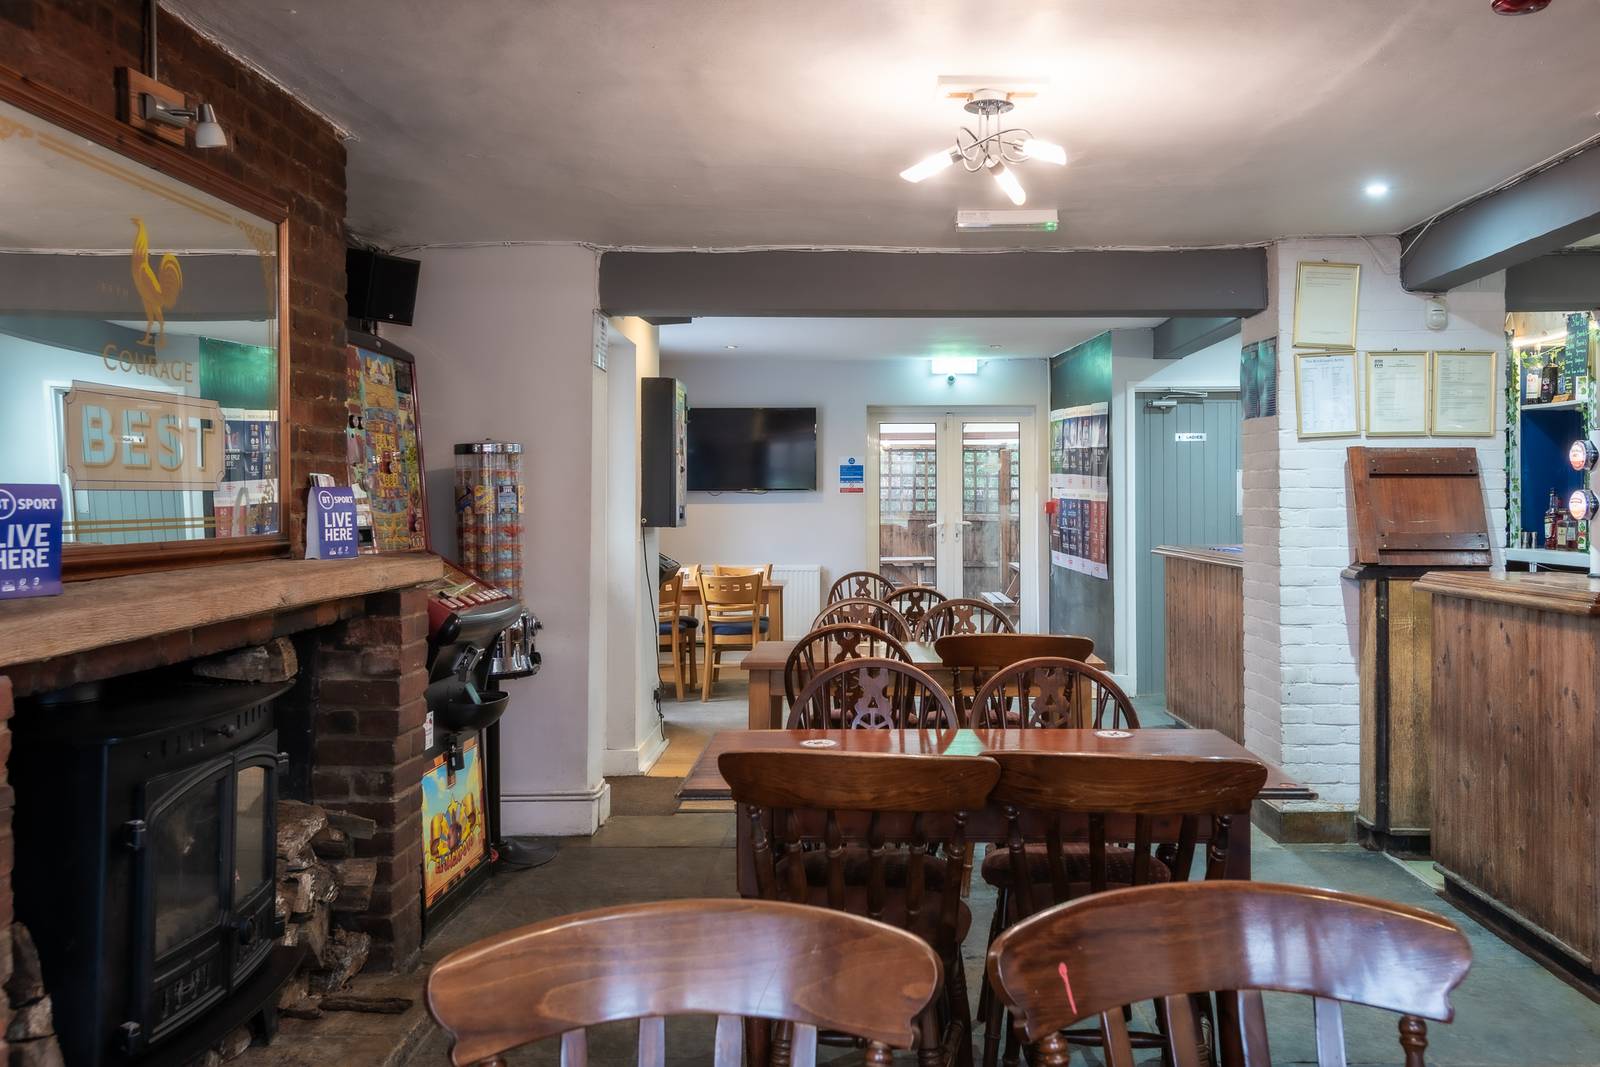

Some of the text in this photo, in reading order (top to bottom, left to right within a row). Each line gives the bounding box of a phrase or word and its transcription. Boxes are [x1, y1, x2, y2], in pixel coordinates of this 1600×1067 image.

[103, 344, 193, 383] COURAGE
[82, 404, 215, 471] BEST
[0, 498, 57, 510] T SPORT
[321, 496, 353, 504] BT SPORT
[324, 512, 353, 528] LIVE
[325, 528, 353, 541] HERE
